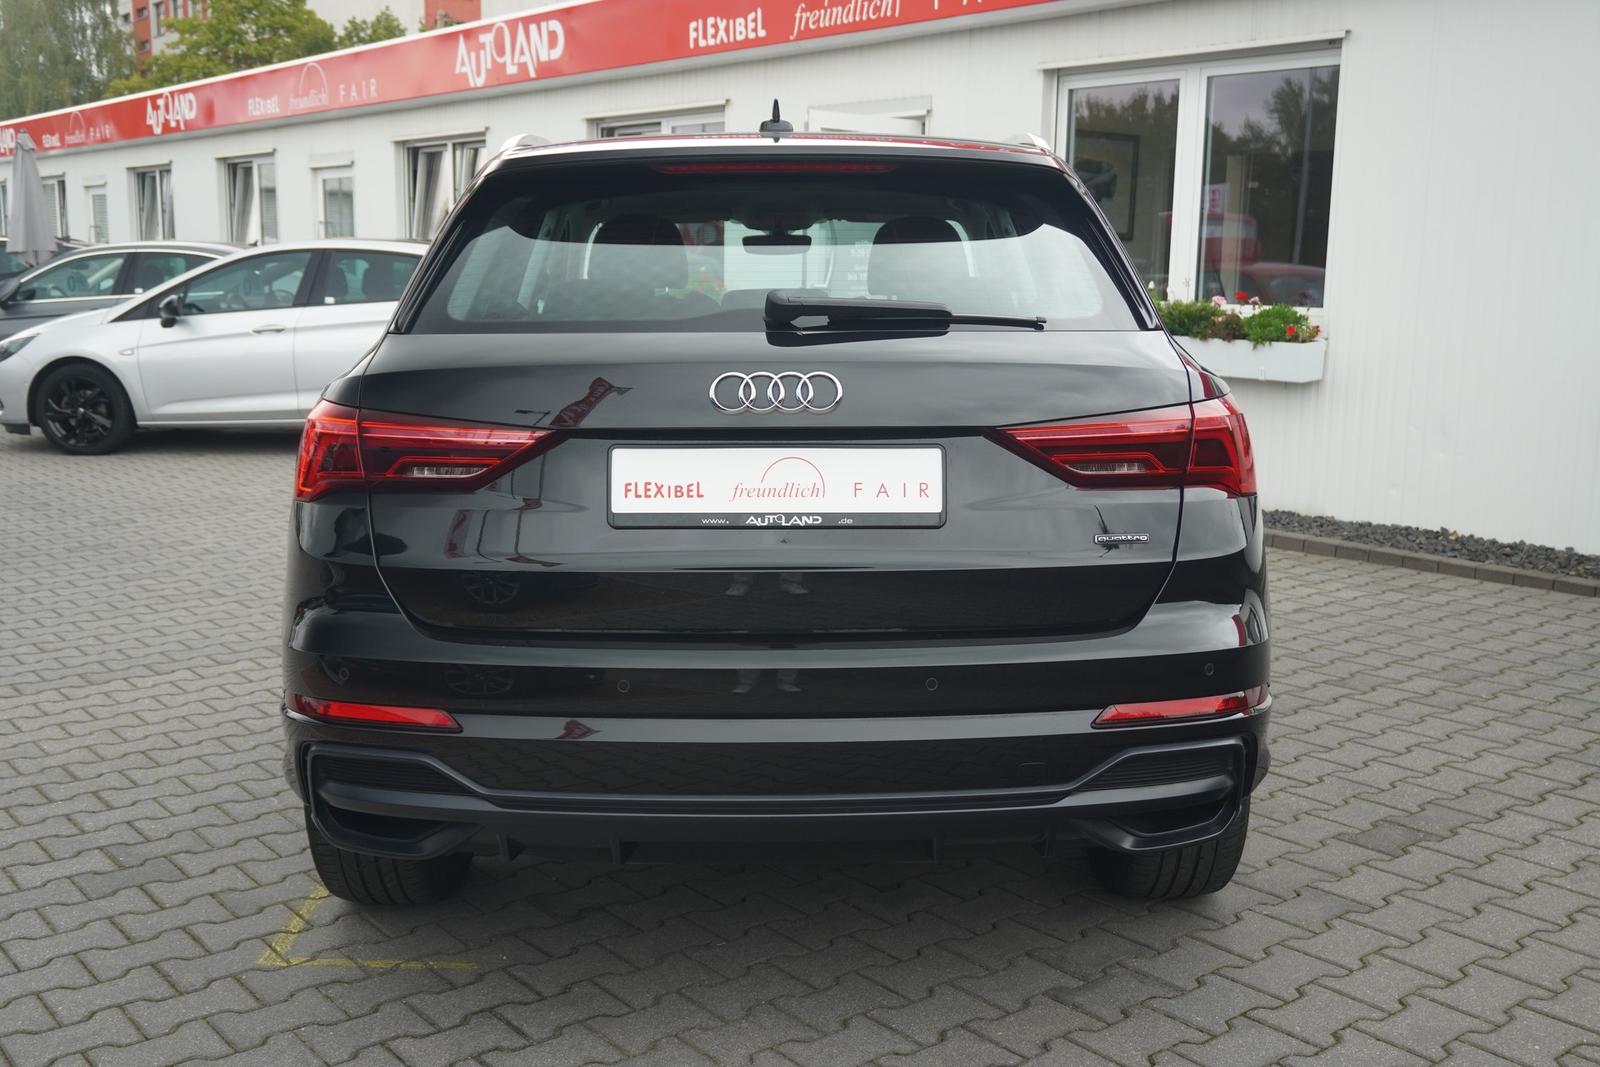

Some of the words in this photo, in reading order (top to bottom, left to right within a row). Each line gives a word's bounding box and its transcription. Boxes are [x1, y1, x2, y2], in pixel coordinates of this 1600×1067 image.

[689, 8, 767, 49] FLEXIBEL
[455, 18, 565, 87] AUTOLAND
[339, 78, 378, 103] FAIR
[146, 90, 197, 135] AUTOLAND
[623, 481, 705, 499] FLEXIBEL
[729, 481, 820, 503] freundlich
[853, 482, 930, 498] FAIR
[745, 514, 822, 526] AUTOLAND
